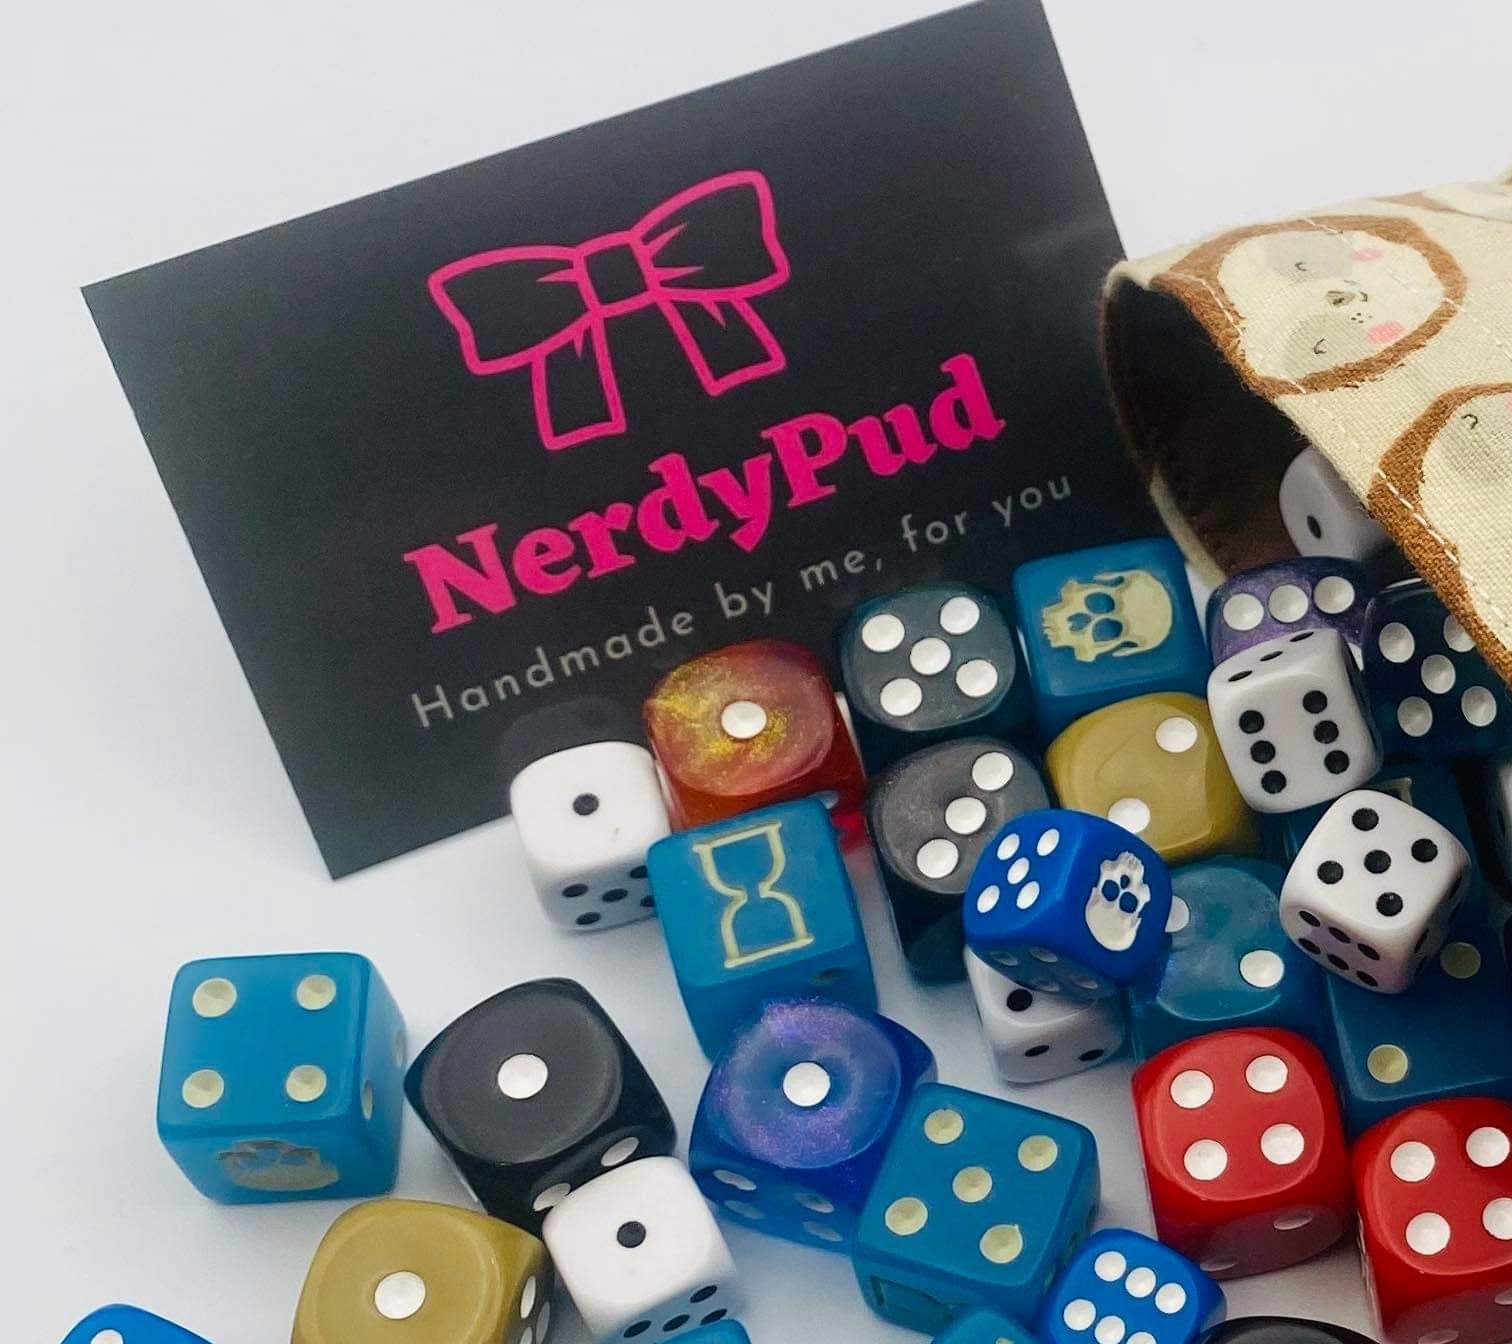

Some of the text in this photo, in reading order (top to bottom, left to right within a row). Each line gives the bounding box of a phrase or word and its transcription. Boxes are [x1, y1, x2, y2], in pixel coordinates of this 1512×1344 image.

[403, 352, 1006, 634] NerdyPud
[410, 473, 1073, 728] Handmade by me, for you
